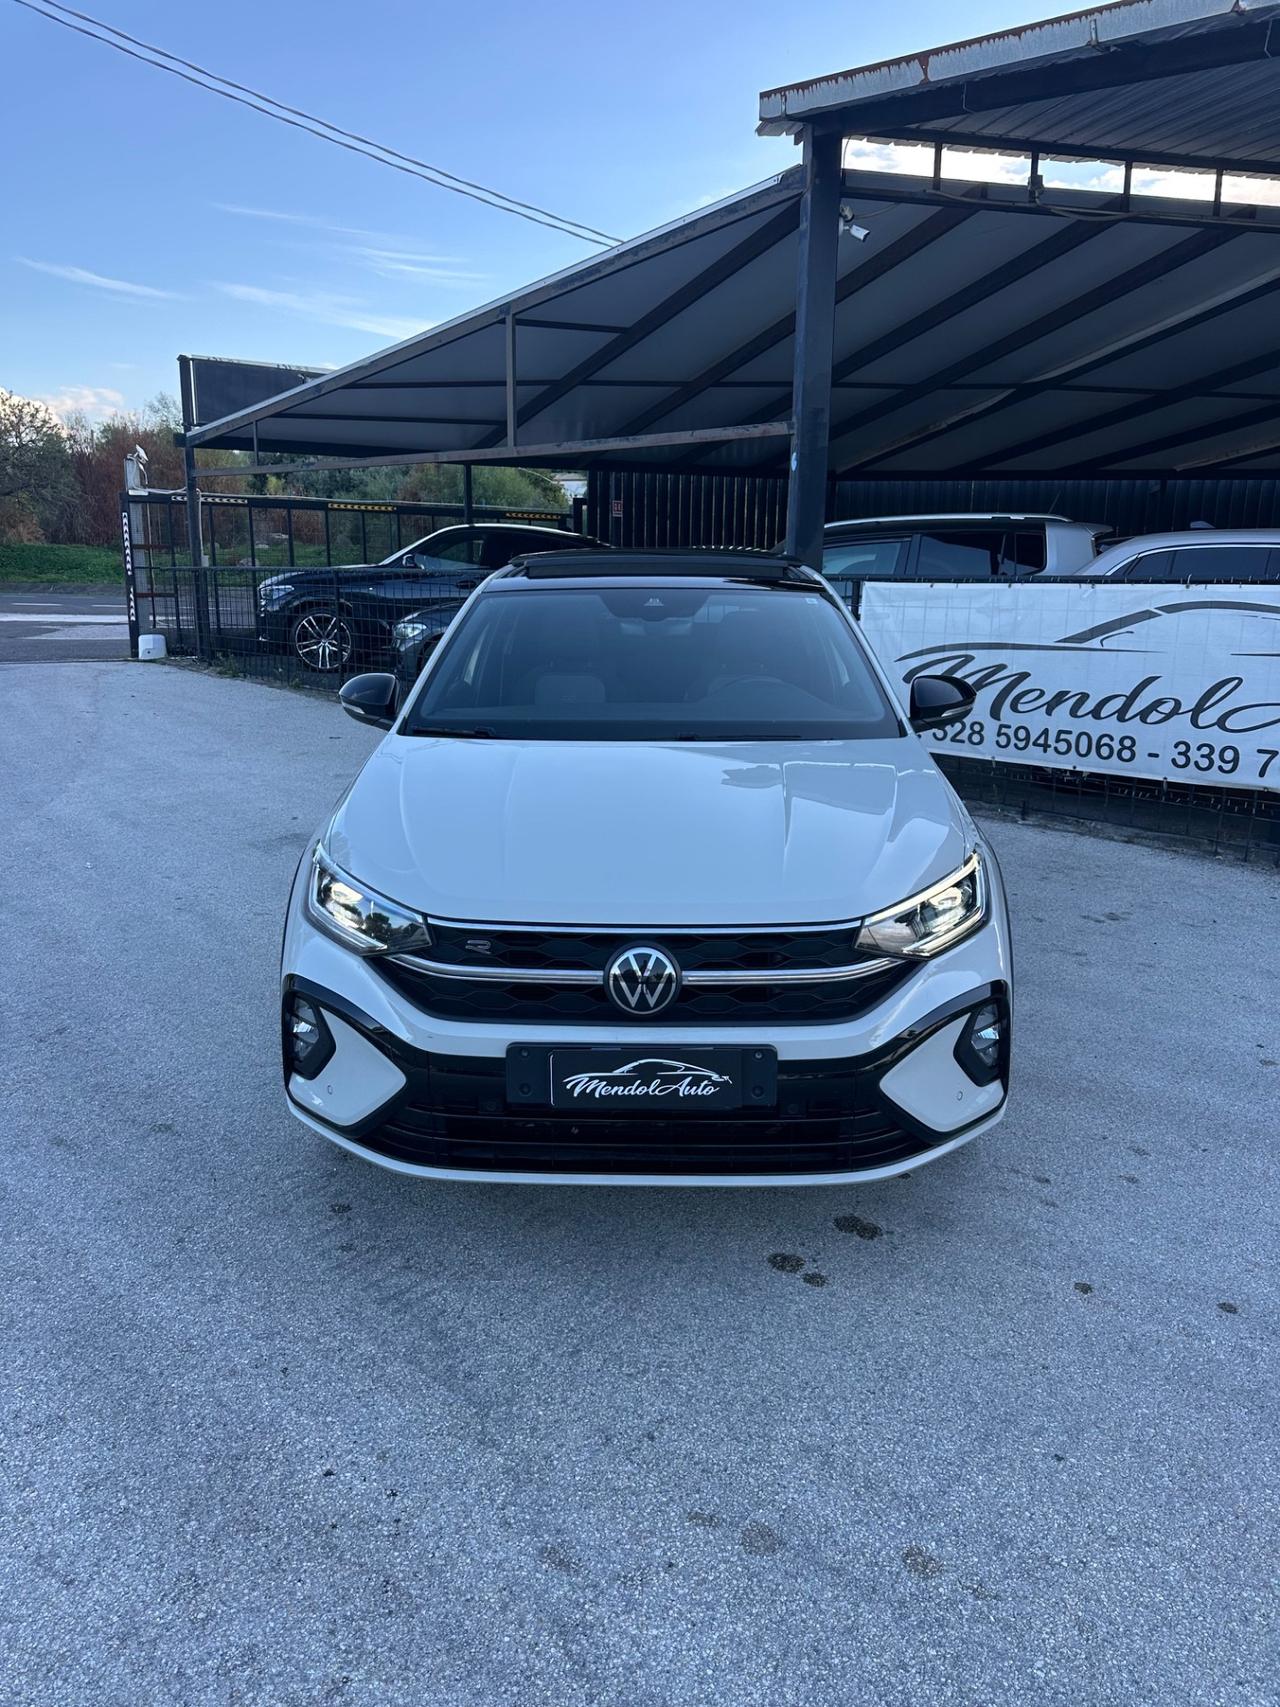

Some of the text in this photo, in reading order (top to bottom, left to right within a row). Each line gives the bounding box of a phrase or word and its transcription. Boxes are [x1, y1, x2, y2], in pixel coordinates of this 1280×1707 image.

[995, 723, 1136, 763] 5945068
[1171, 740, 1240, 774] 339
[566, 1075, 720, 1098] MendolAuto
